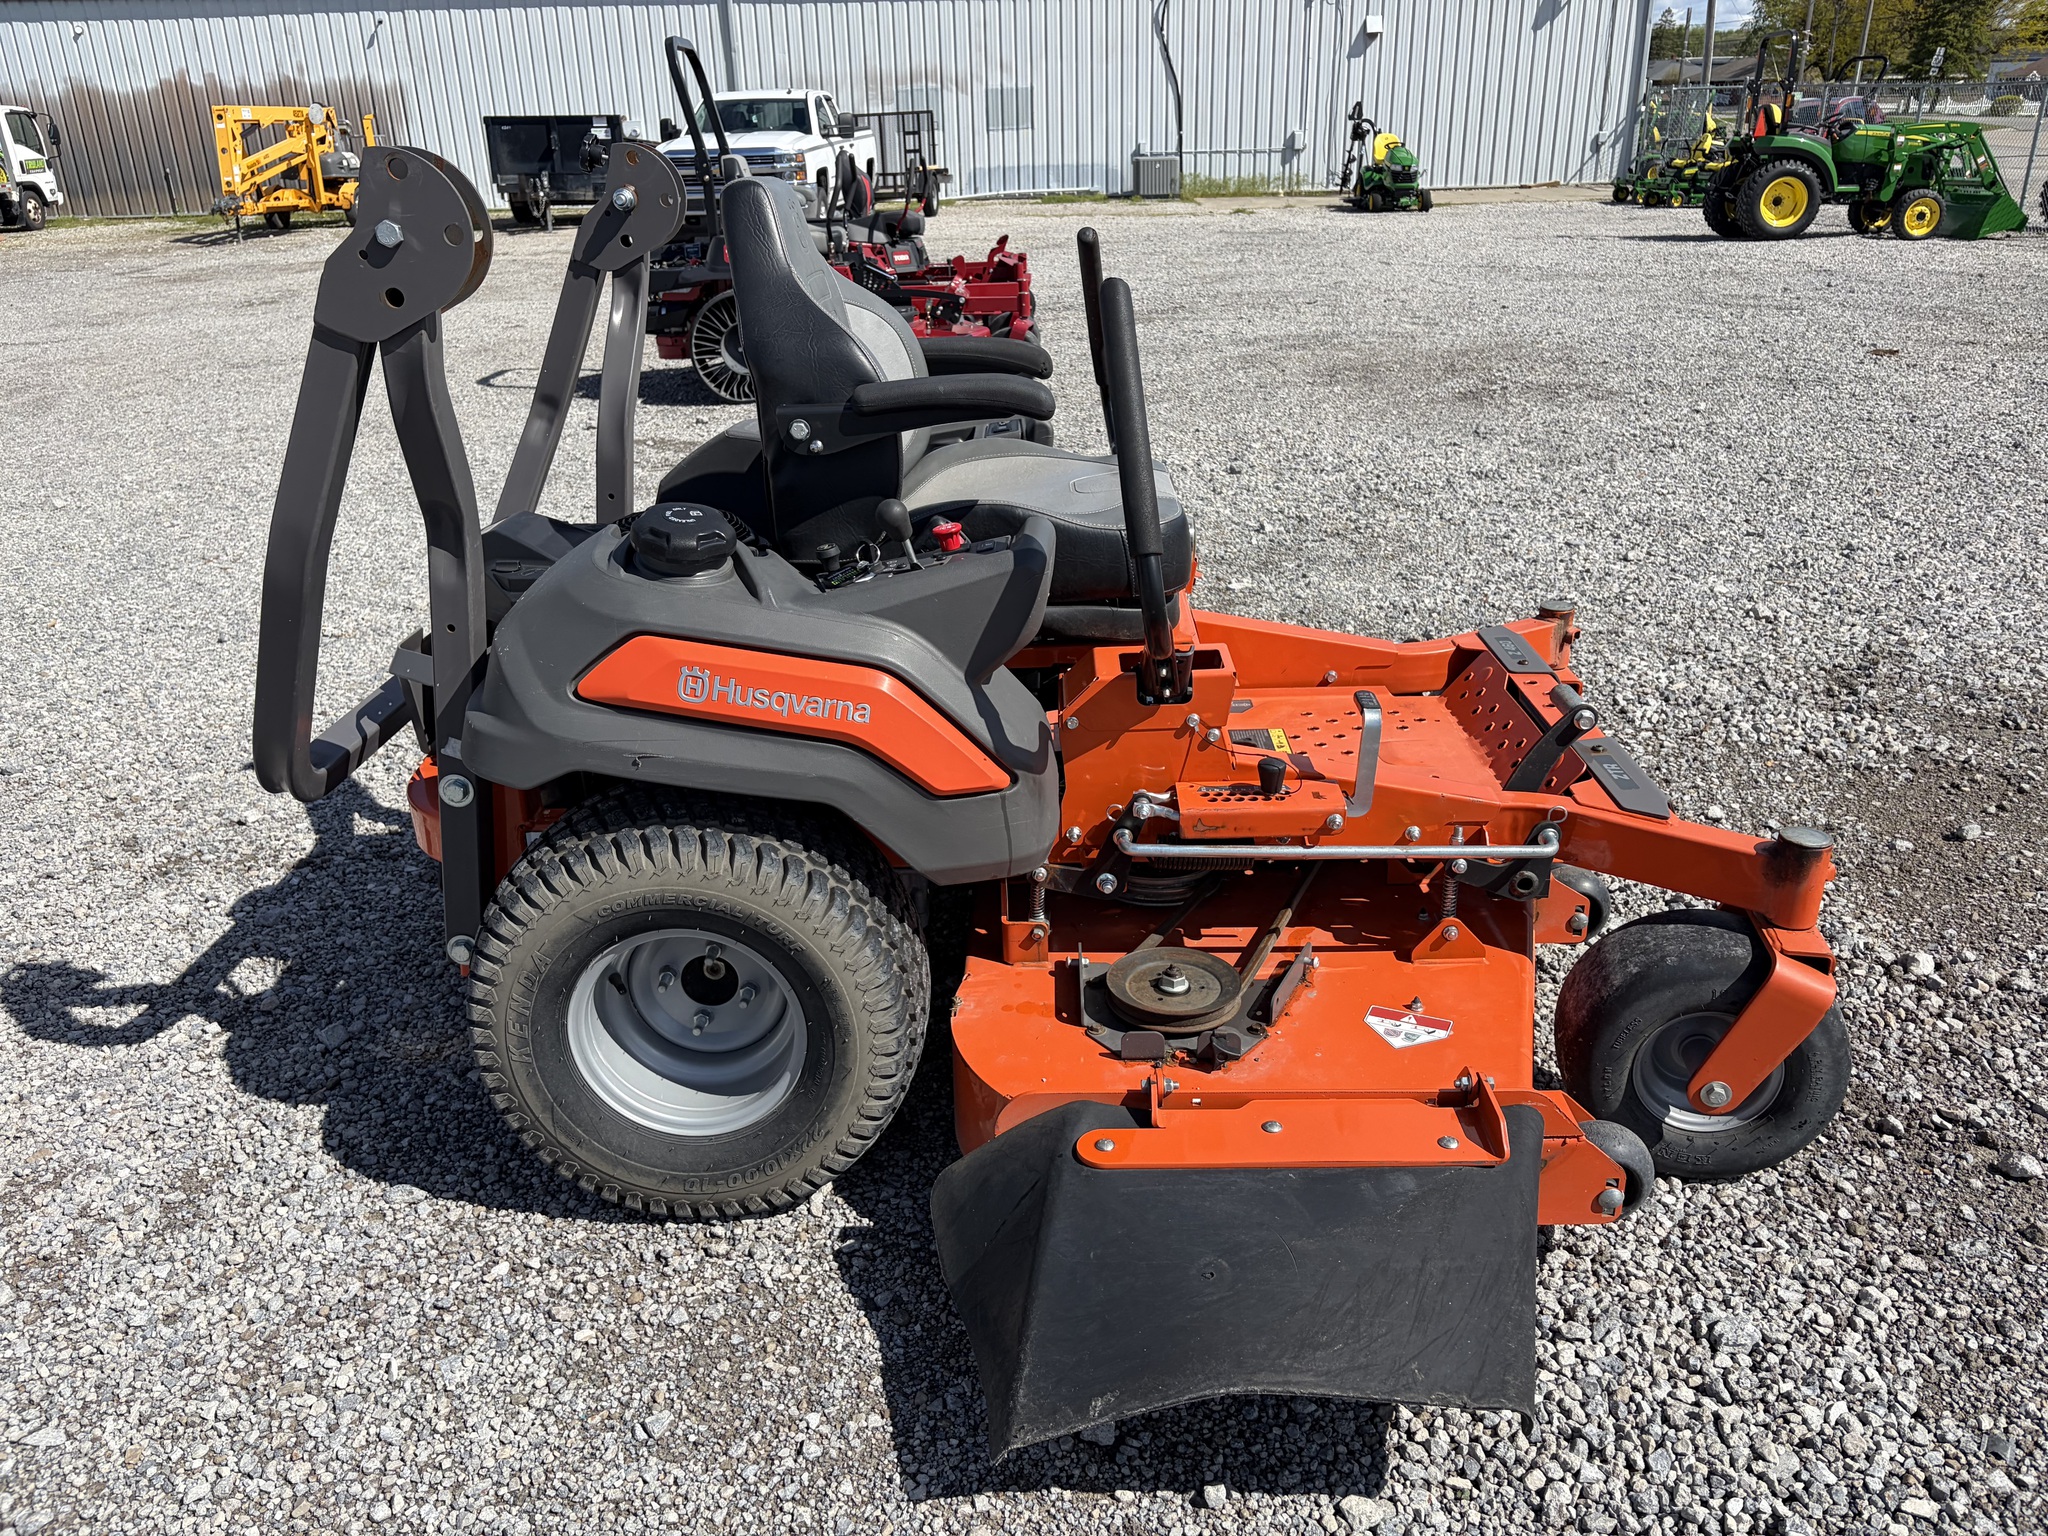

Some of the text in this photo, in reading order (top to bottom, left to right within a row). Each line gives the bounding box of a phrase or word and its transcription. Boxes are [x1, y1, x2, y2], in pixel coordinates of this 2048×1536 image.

[711, 675, 872, 724] Husqvarna
[1602, 762, 1630, 781] ZTR
[598, 892, 807, 953] COMMERCIAL TURF
[507, 949, 552, 1066] KENDA
[1656, 1146, 1712, 1166] KEN
